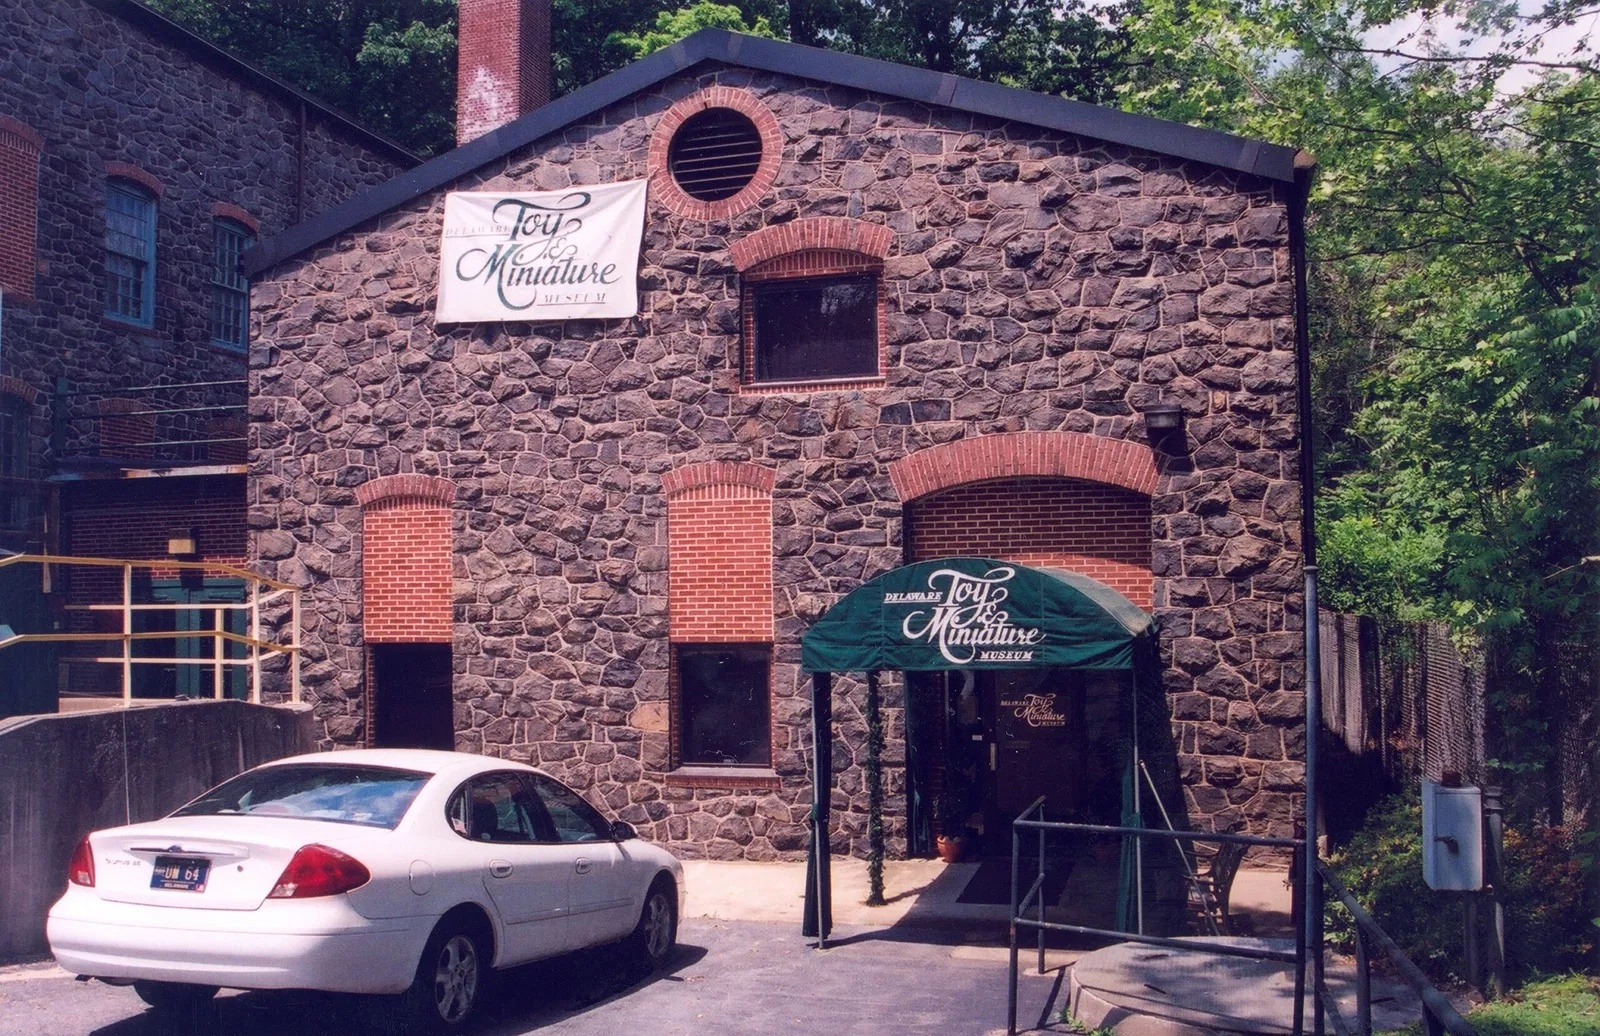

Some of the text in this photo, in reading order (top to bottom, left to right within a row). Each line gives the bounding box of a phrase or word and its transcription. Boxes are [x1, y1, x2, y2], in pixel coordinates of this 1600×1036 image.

[492, 192, 592, 265] Toy
[456, 243, 623, 310] Miniature
[544, 292, 606, 303] MUSEUM
[885, 567, 1016, 628] DELAWARE Toy
[902, 606, 1047, 664] Miniature
[980, 650, 1034, 660] MUSEUM
[1014, 706, 1066, 727] Miniature
[1024, 693, 1056, 713] Toy
